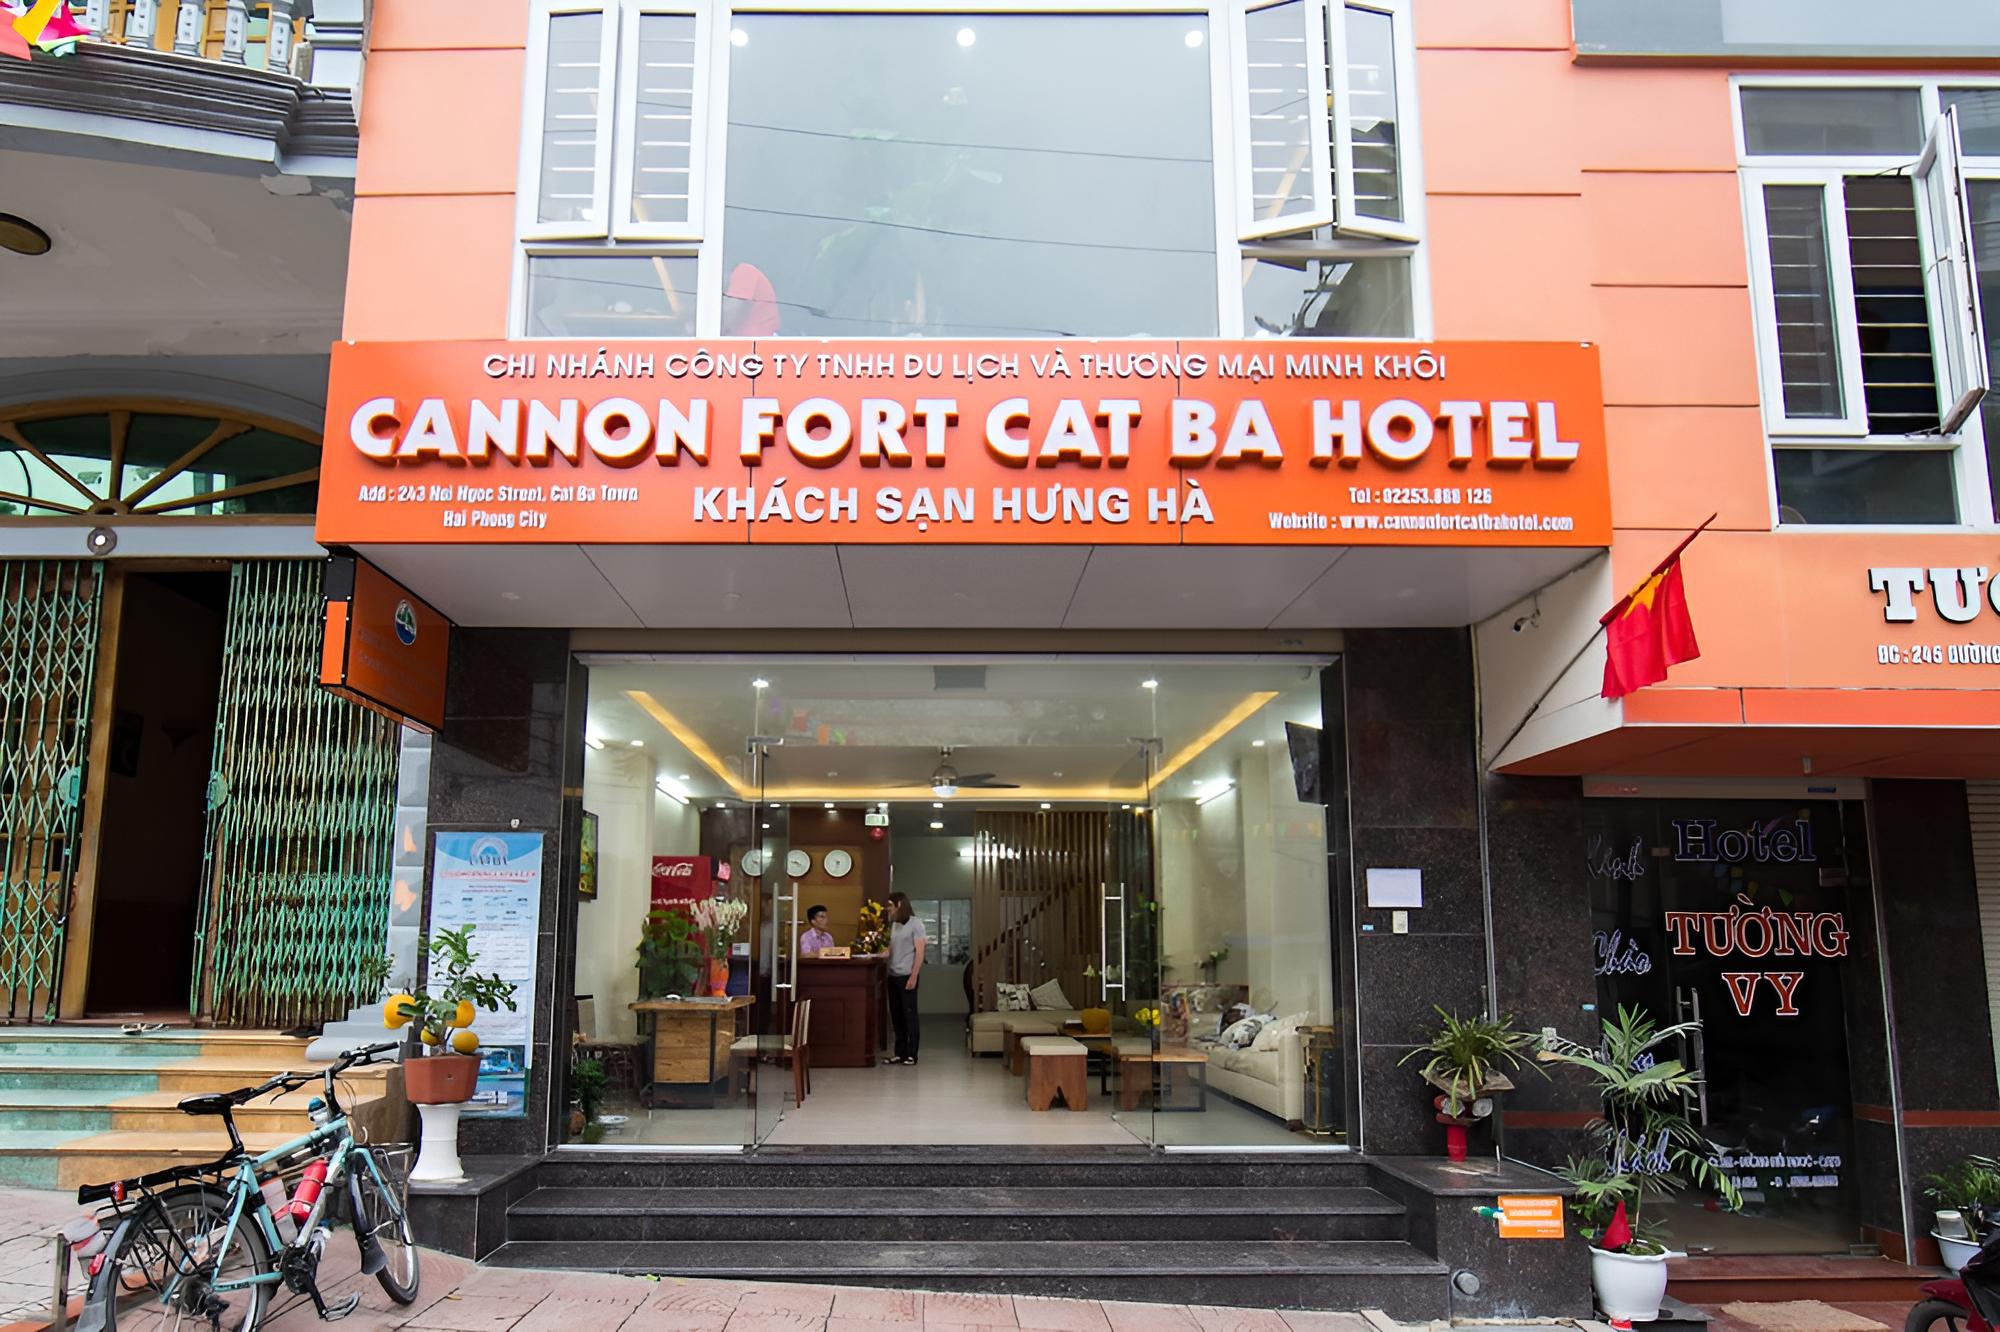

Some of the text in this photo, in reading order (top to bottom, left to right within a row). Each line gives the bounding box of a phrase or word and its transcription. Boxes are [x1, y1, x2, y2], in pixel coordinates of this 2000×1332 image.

[483, 347, 1446, 384] CHI NHÁNH CÔNG TY TNHH DU LỊCH VÀ THƯƠNG MẠI MINH KHÔI
[349, 396, 1580, 469] CANNON FORT CAT BA HOTEL
[600, 485, 640, 502] Town
[692, 477, 1215, 531] KHÁCH SẠN HƯNG HÀ
[443, 509, 548, 529] Hai Phong City
[1868, 567, 2000, 625] TƯ
[1672, 819, 1817, 862] Hotel
[1665, 892, 1850, 958] TƯỜNG
[1721, 971, 1804, 1017] VY
